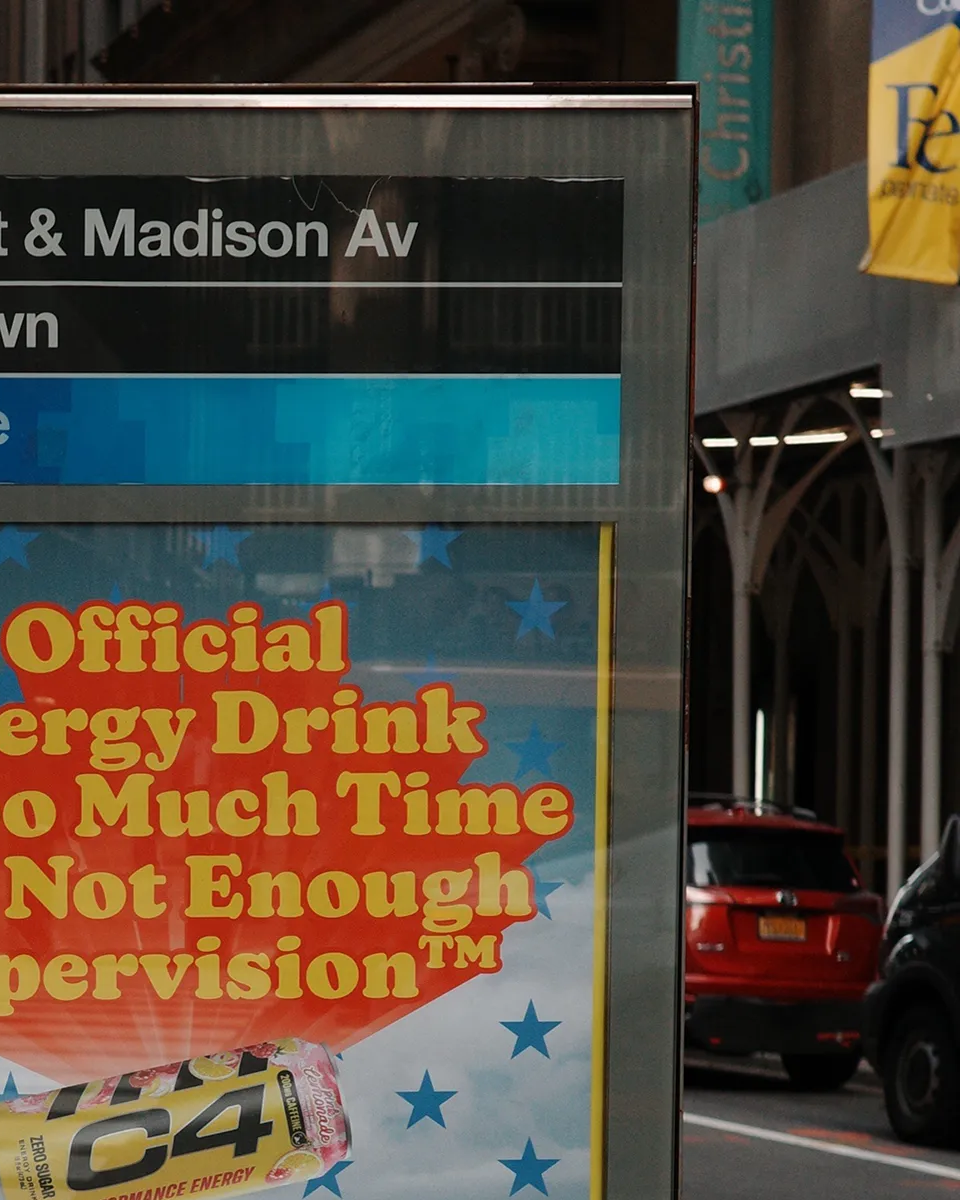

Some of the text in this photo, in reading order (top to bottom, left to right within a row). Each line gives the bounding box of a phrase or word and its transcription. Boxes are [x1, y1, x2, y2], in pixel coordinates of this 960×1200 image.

[24, 208, 67, 257] &
[84, 208, 328, 258] Madison
[344, 208, 419, 257] Av
[5, 604, 345, 674] Official
[211, 687, 483, 755] Drink
[74, 770, 320, 838] Much
[336, 770, 569, 836] Time
[4, 855, 168, 920] Not
[184, 851, 533, 933] Enough
[66, 1082, 275, 1192] C4
[285, 1096, 300, 1132] CAFFEINE
[29, 1135, 56, 1200] ZERO SUGAR
[189, 1165, 256, 1197] ENERGY
